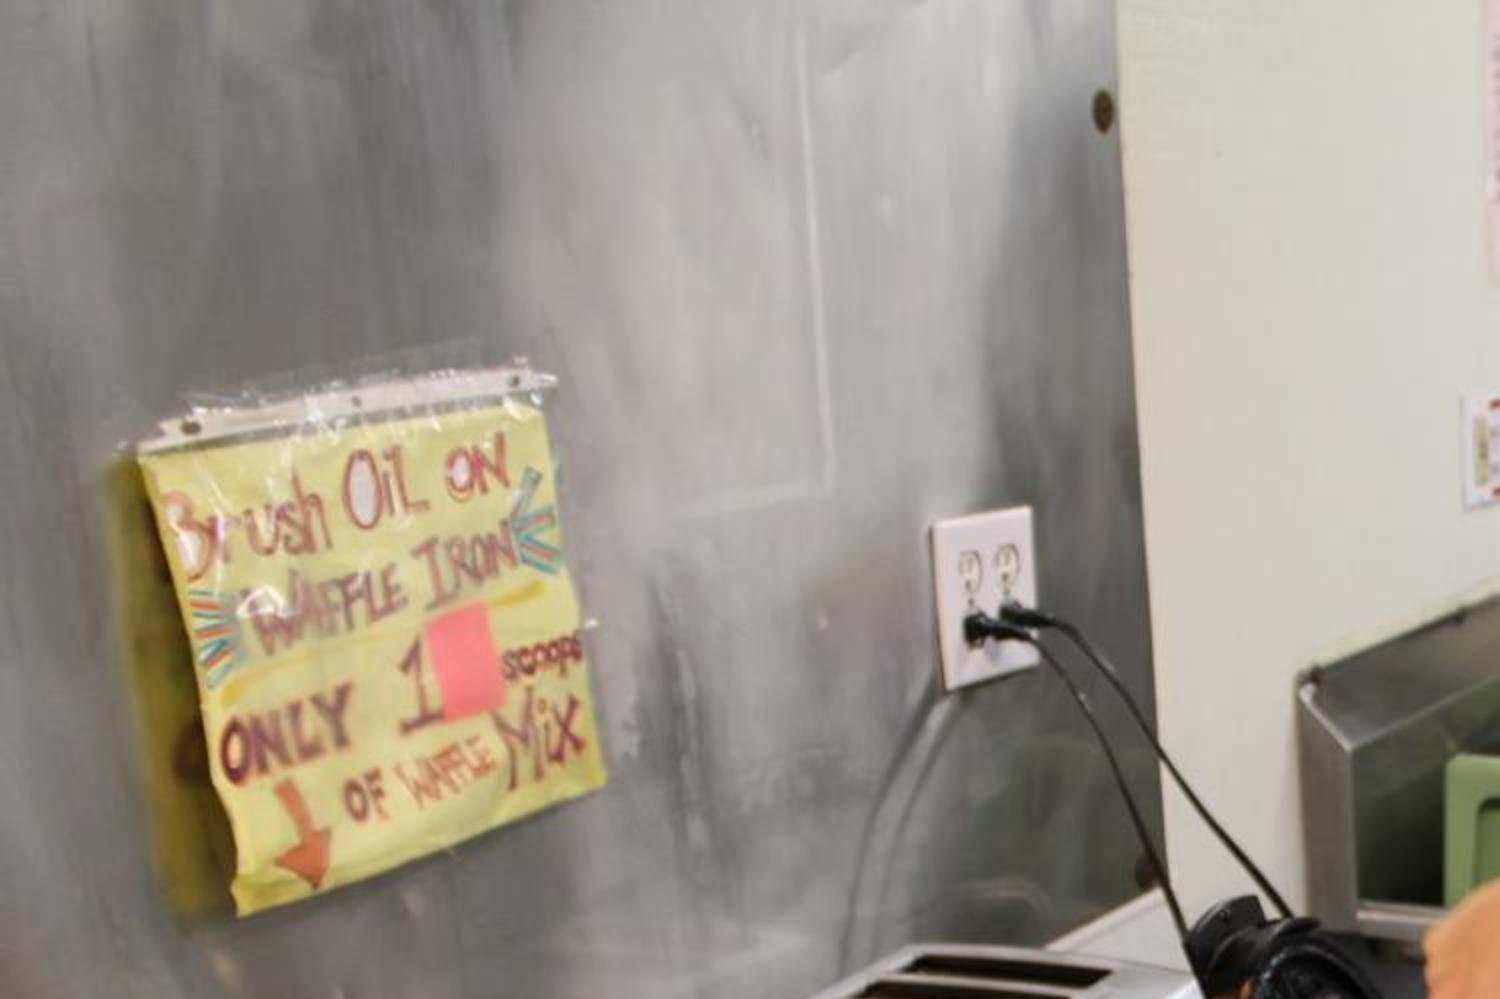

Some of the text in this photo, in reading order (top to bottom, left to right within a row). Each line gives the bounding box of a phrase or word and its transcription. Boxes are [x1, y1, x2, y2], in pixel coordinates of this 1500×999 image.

[242, 520, 519, 658] WAFFLE IRON
[221, 682, 354, 787] ONLY
[343, 765, 389, 823] OF
[393, 734, 499, 811] WAFFLE
